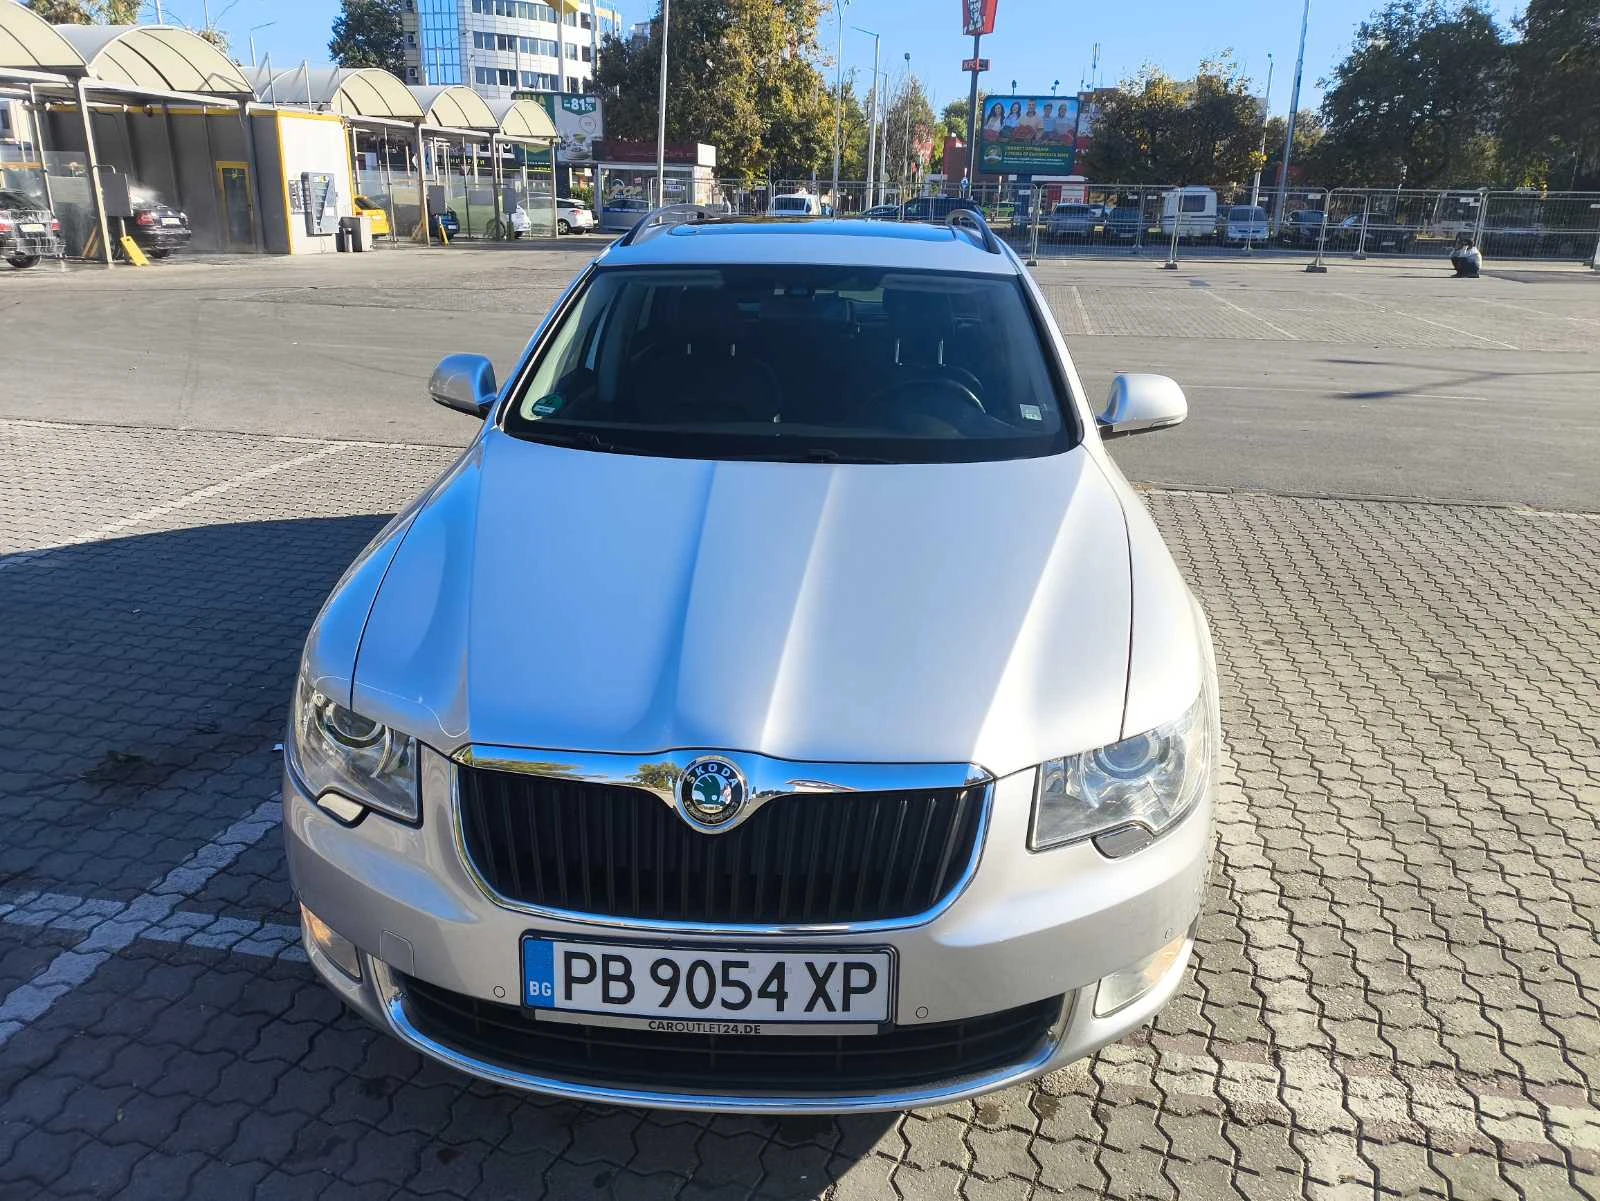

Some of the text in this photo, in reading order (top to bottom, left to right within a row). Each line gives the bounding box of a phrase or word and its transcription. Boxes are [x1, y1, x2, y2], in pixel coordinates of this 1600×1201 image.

[563, 97, 593, 111] -81%
[529, 981, 552, 996] BG
[564, 951, 878, 1013] PB 9054 XP
[648, 1020, 761, 1035] CAROUTLET24.DE
